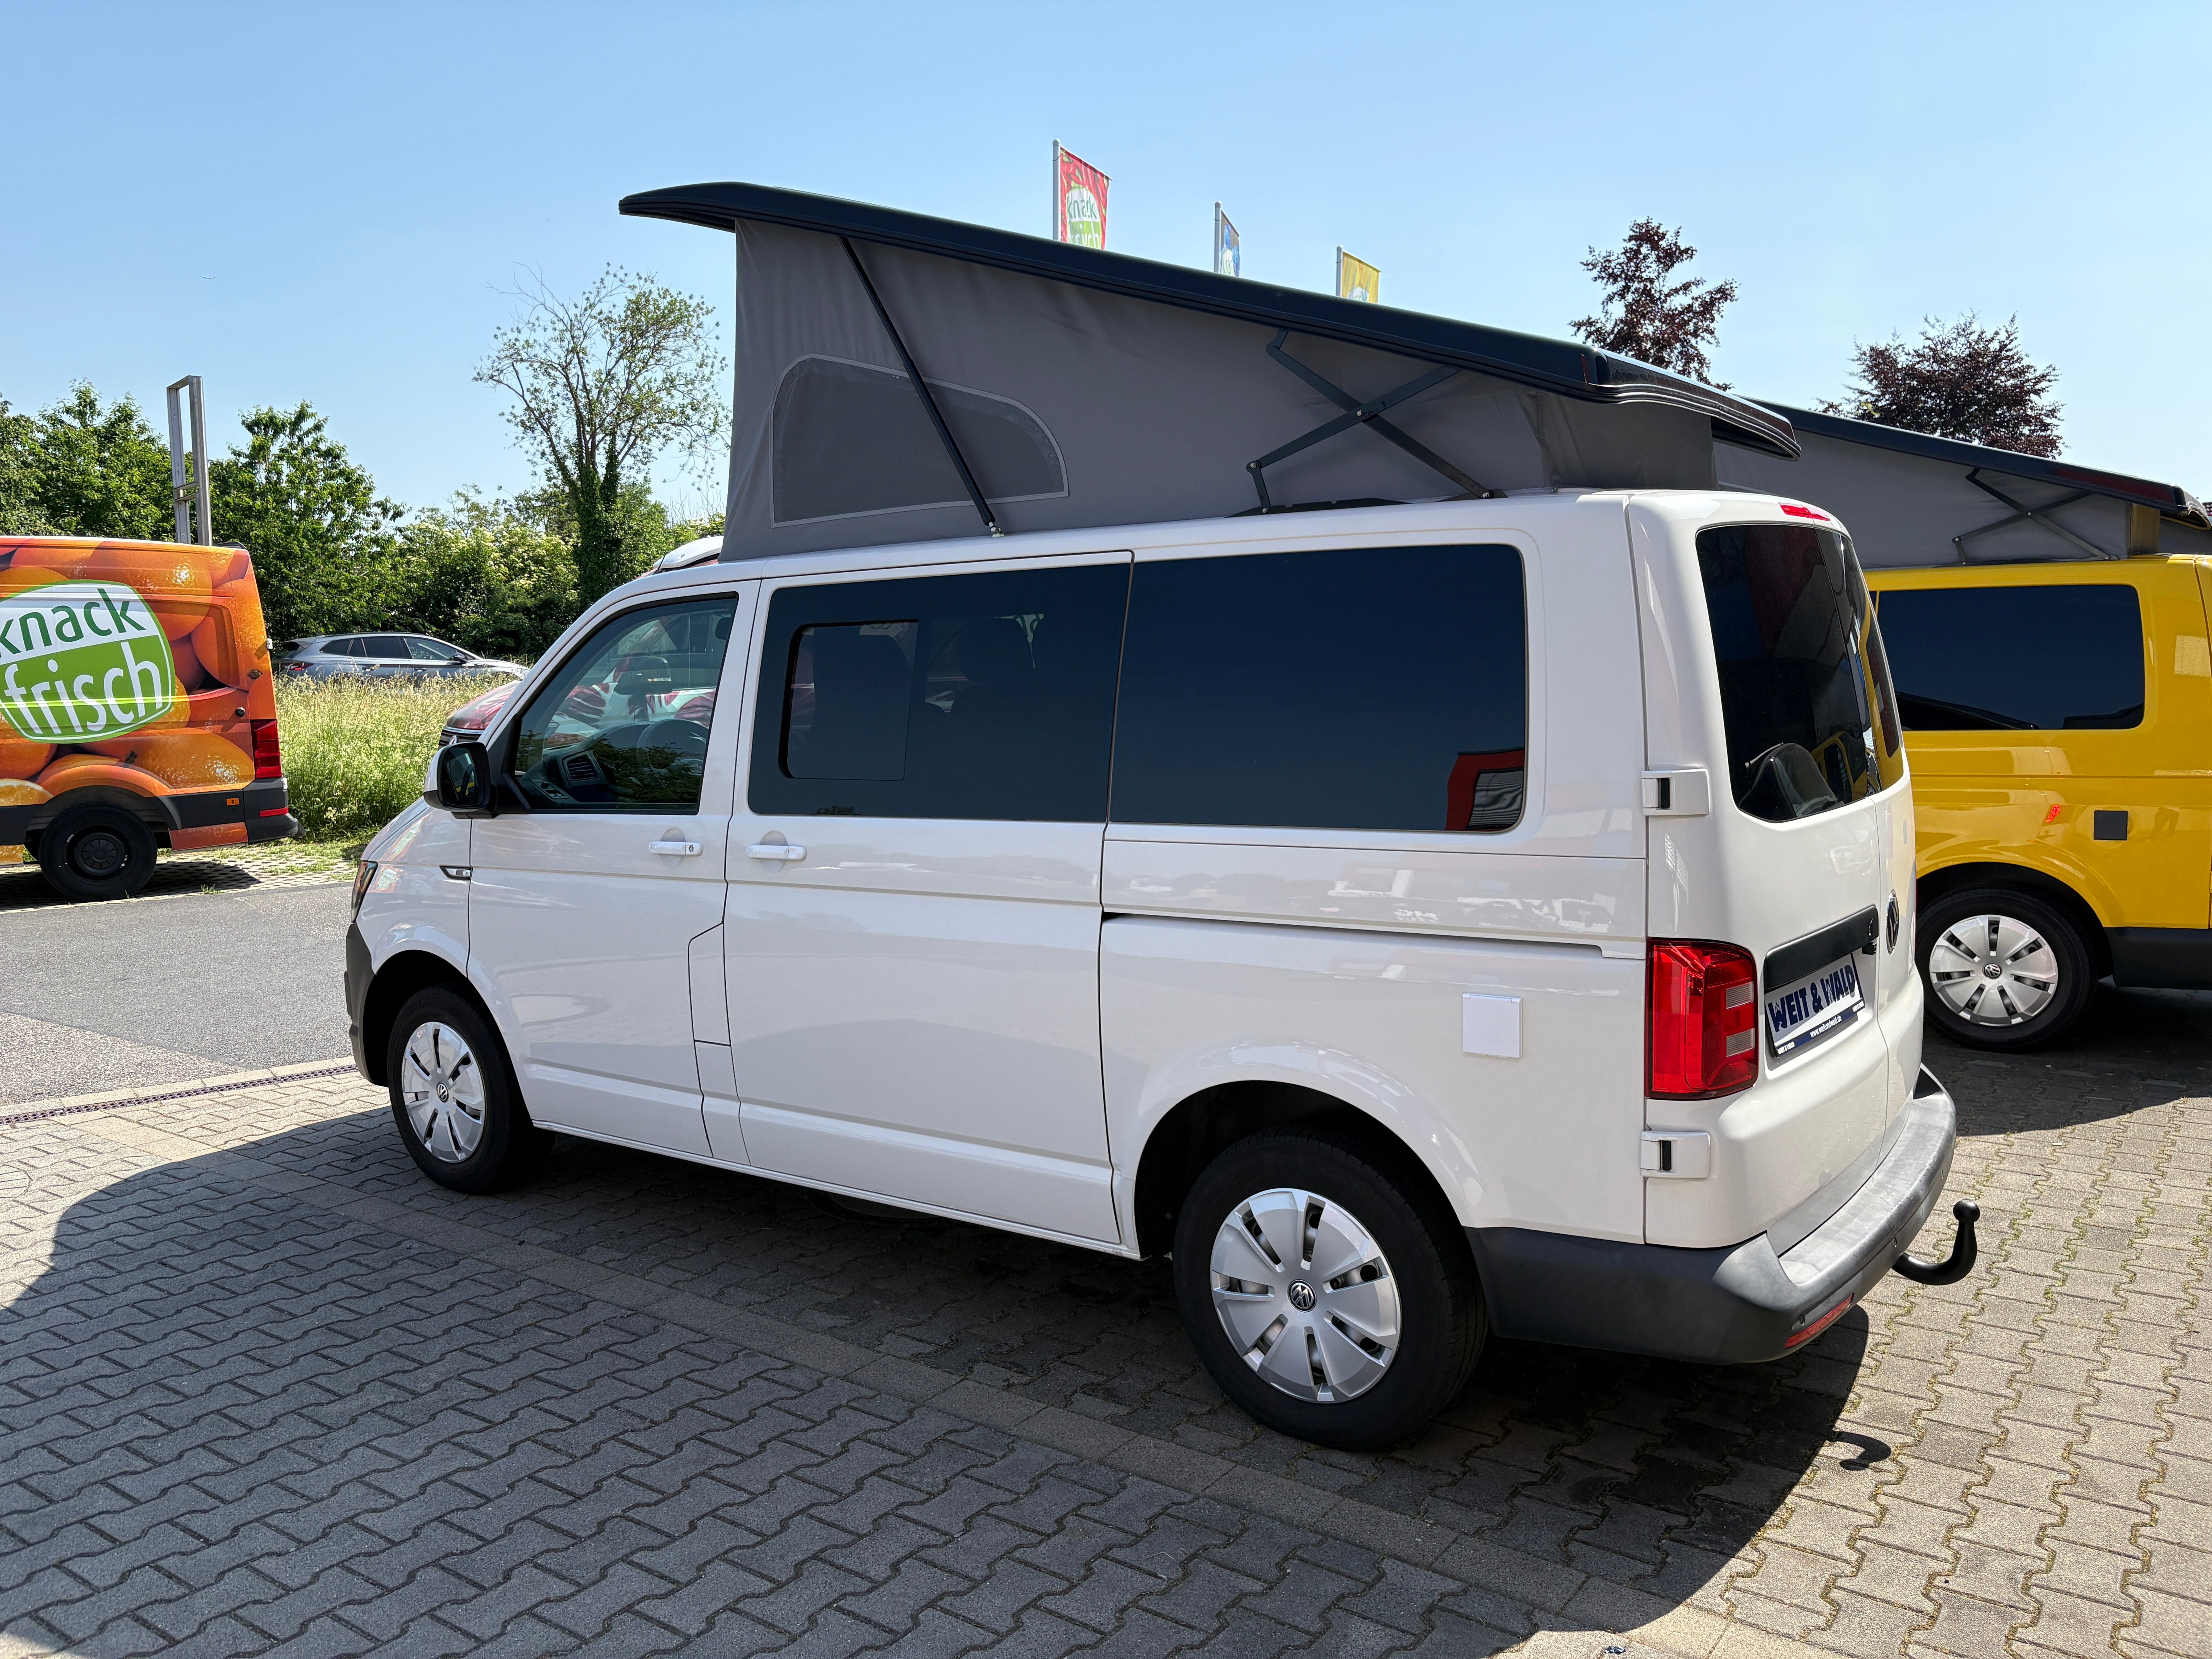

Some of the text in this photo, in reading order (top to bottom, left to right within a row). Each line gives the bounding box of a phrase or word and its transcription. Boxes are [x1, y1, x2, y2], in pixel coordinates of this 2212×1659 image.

[4, 641, 163, 735] frisch
[1767, 987, 1810, 1033] WEIT
[1810, 982, 1824, 1013] &
